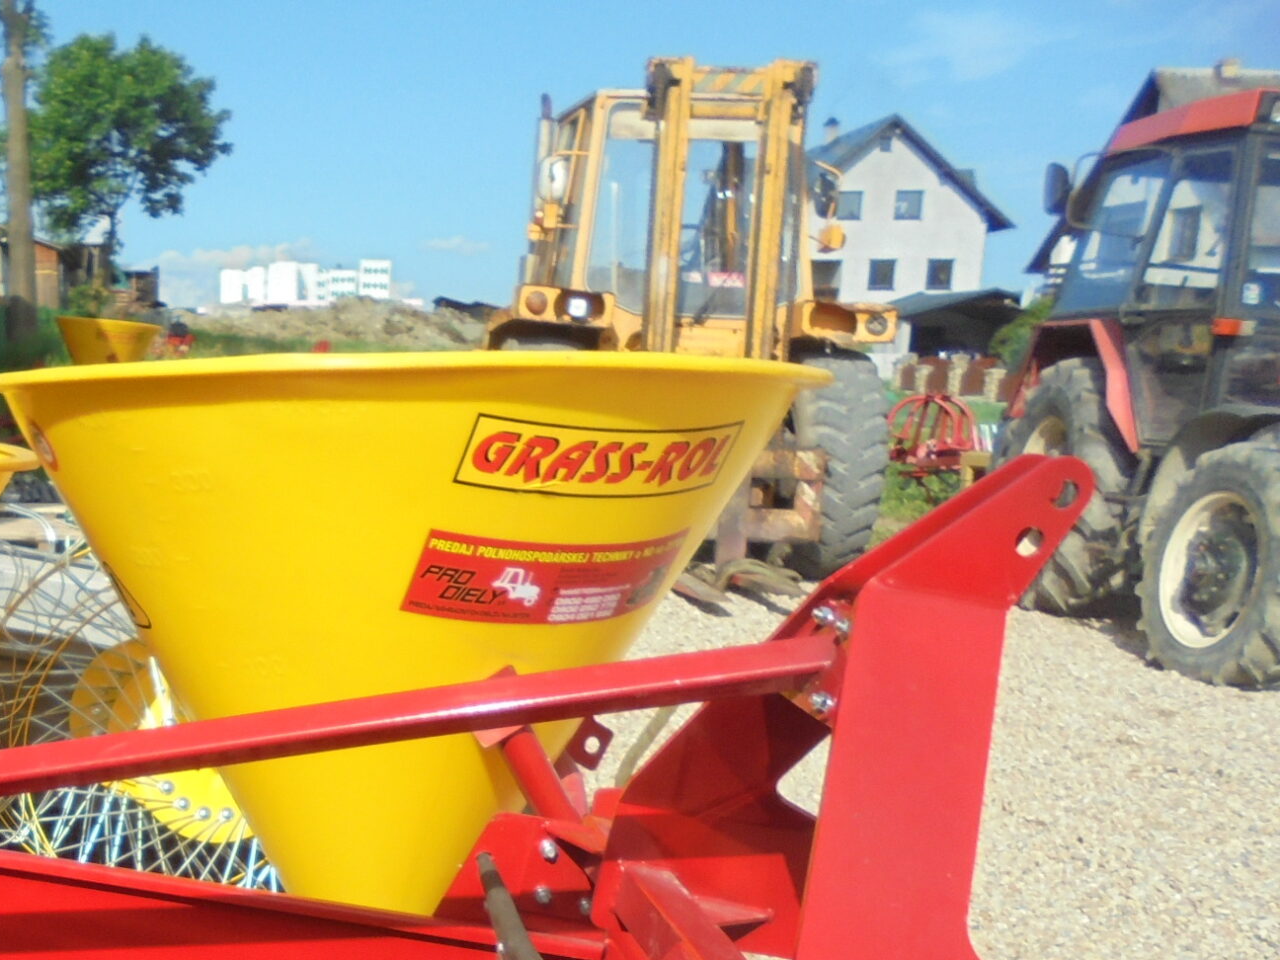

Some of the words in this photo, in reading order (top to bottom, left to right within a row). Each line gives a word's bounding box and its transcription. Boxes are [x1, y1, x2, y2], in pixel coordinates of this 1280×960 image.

[472, 431, 731, 487] GRASS-ROL
[428, 537, 474, 556] PREDAJ
[420, 564, 477, 586] PRO
[438, 584, 507, 605] DIELY
